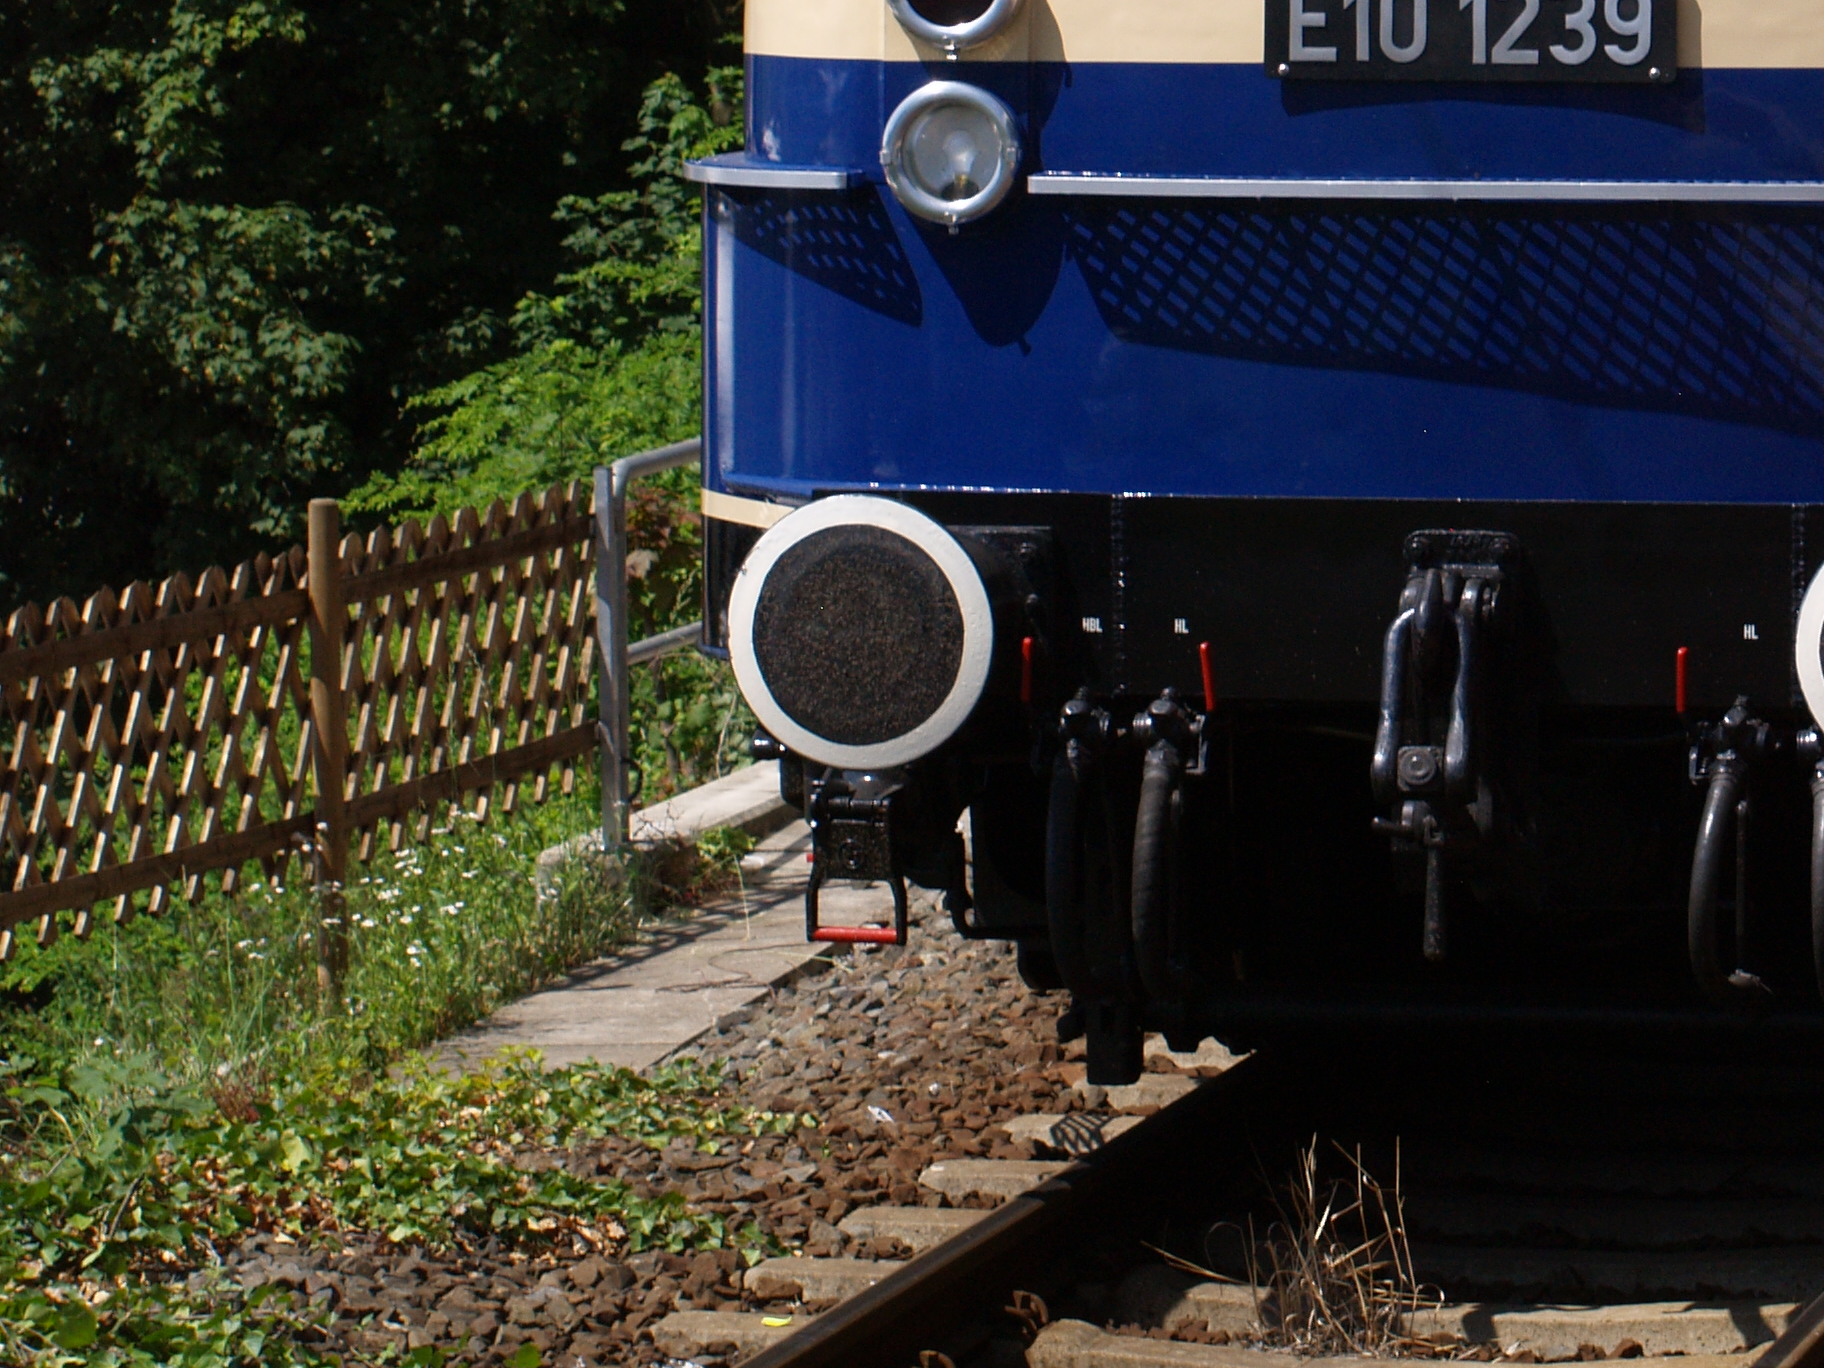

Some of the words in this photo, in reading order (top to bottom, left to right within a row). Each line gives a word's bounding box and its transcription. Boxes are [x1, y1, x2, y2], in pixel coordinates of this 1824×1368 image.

[1082, 617, 1103, 633] HBL
[1174, 618, 1189, 634] HL
[1743, 623, 1759, 640] HL
